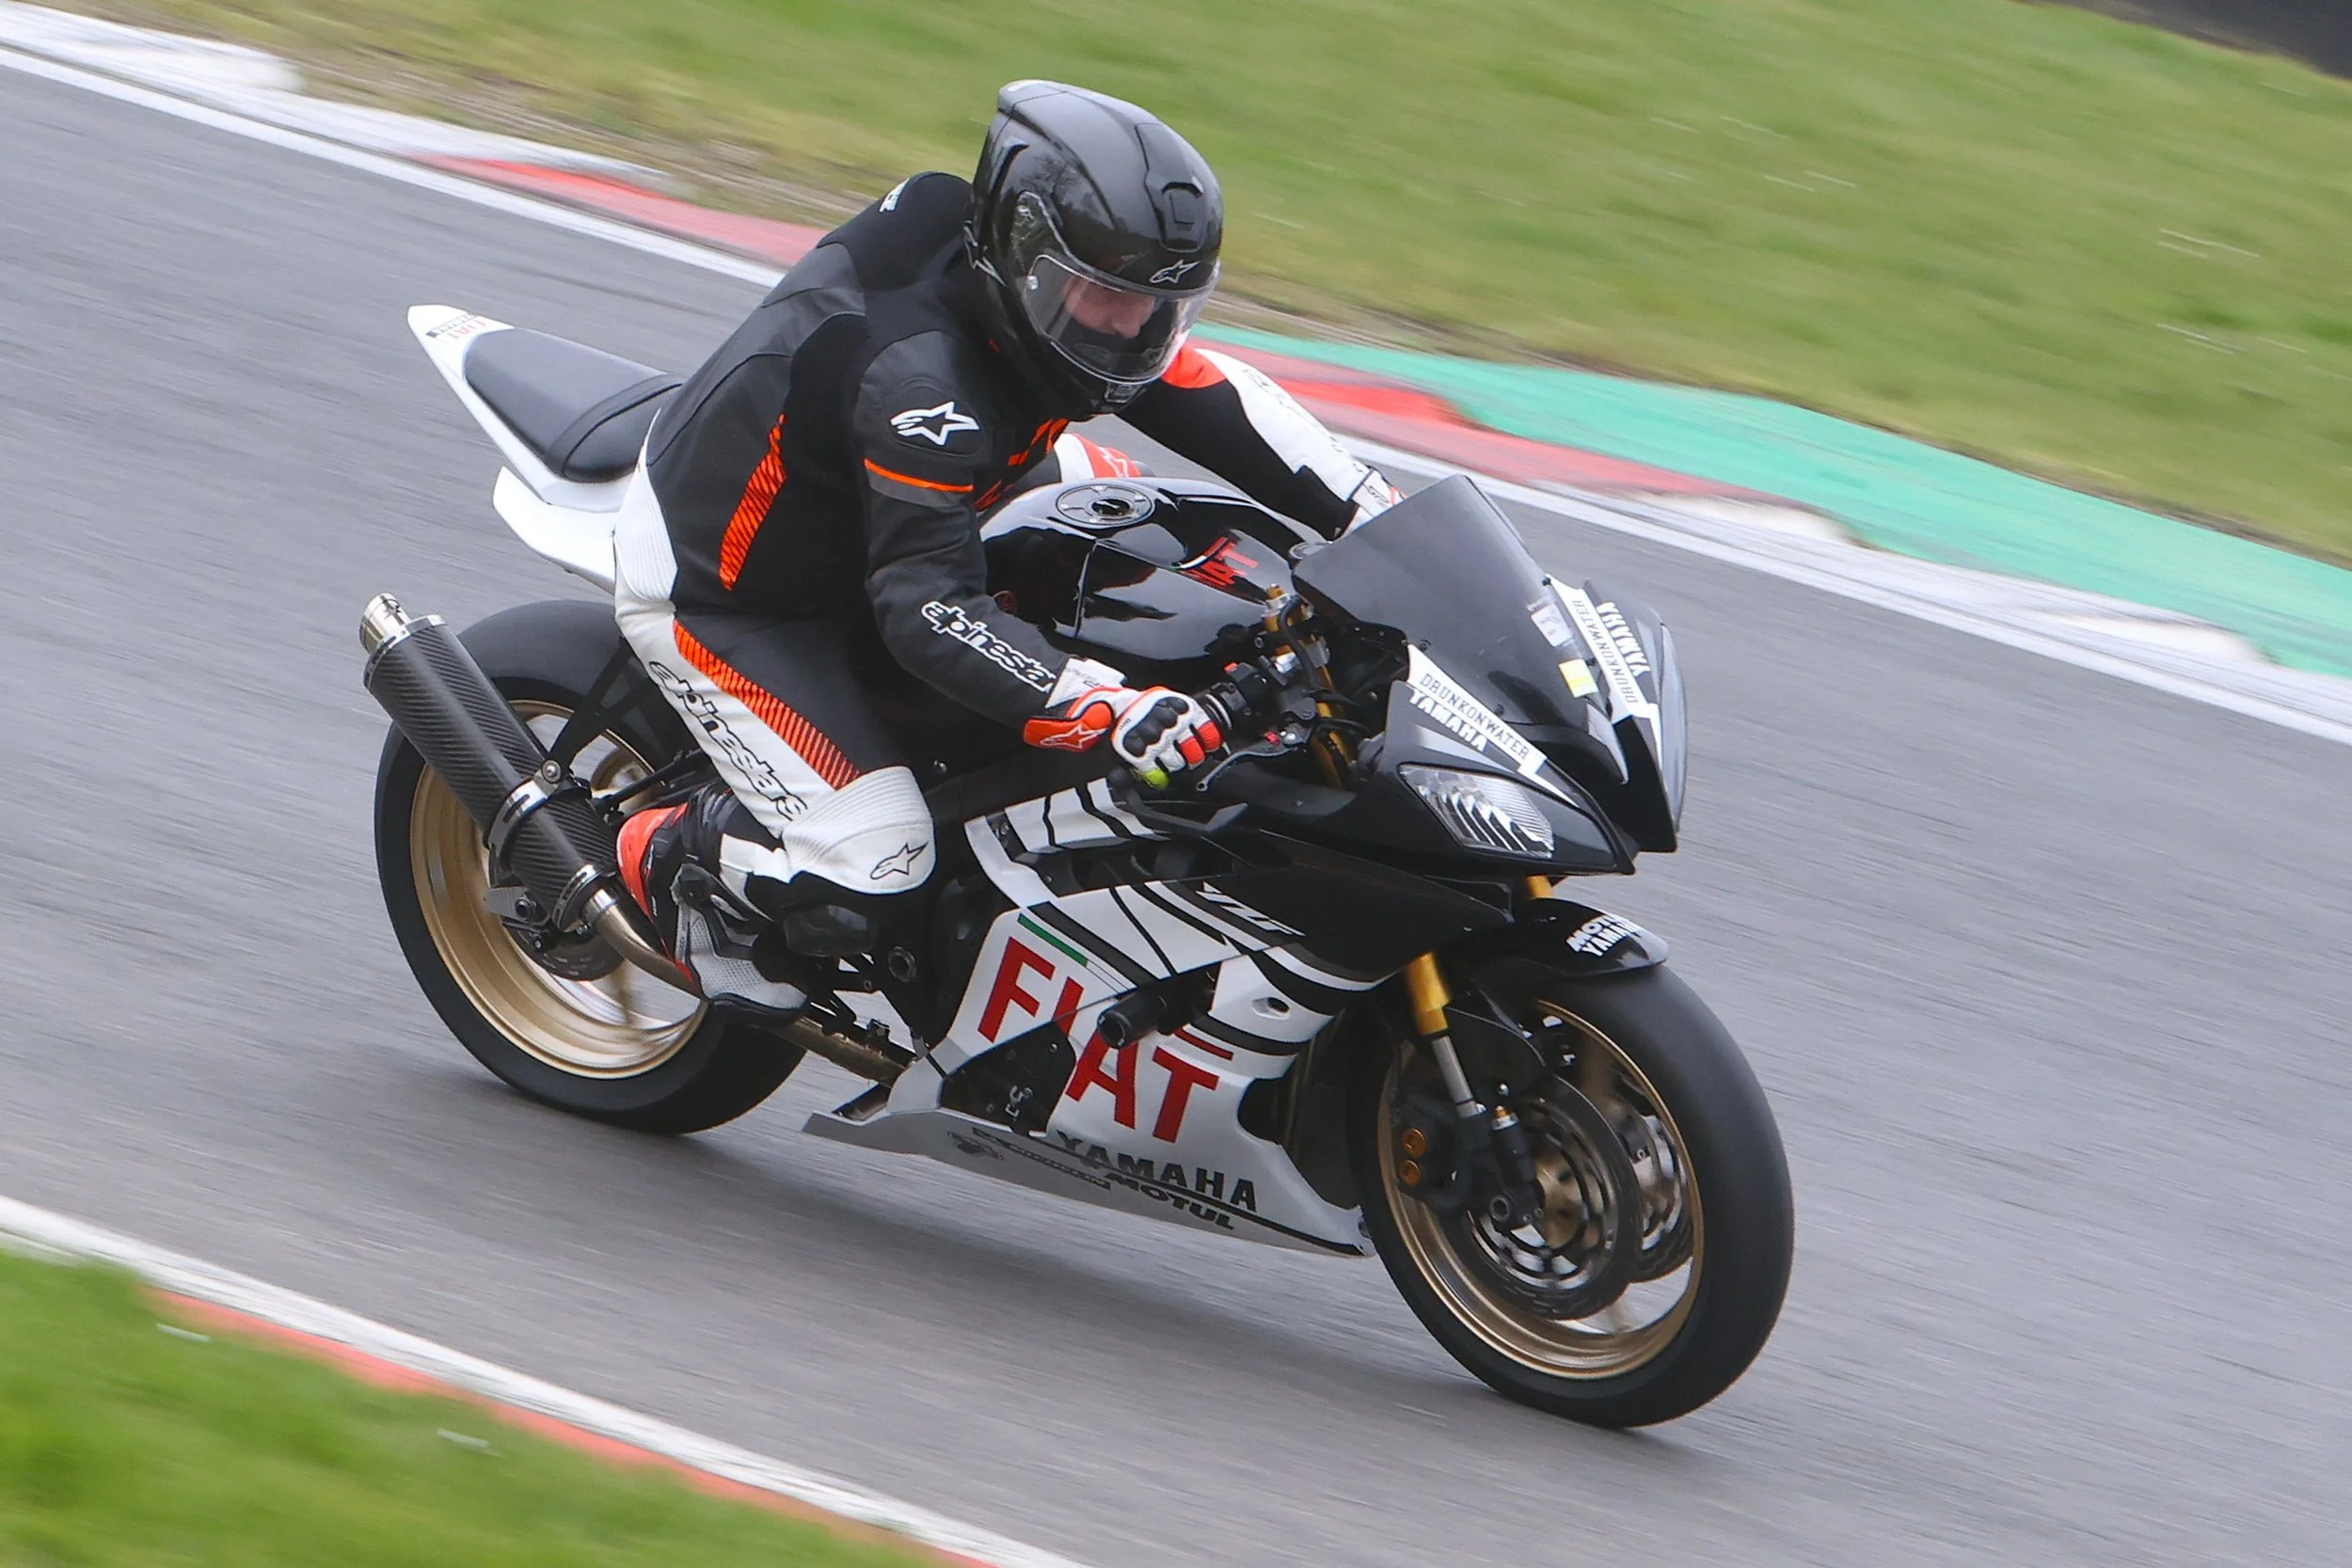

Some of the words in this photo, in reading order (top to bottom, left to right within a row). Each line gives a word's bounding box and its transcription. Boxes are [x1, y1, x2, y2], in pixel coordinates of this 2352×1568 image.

[921, 601, 1057, 693] alpinestar
[1596, 602, 1651, 678] YAMAHA
[1409, 689, 1489, 752] YAMAHA
[1420, 673, 1531, 760] DRUNKONWATER
[977, 935, 1221, 1145] FIAT
[1057, 1130, 1258, 1214] YAMAHA
[1104, 1171, 1235, 1231] MOTUL
